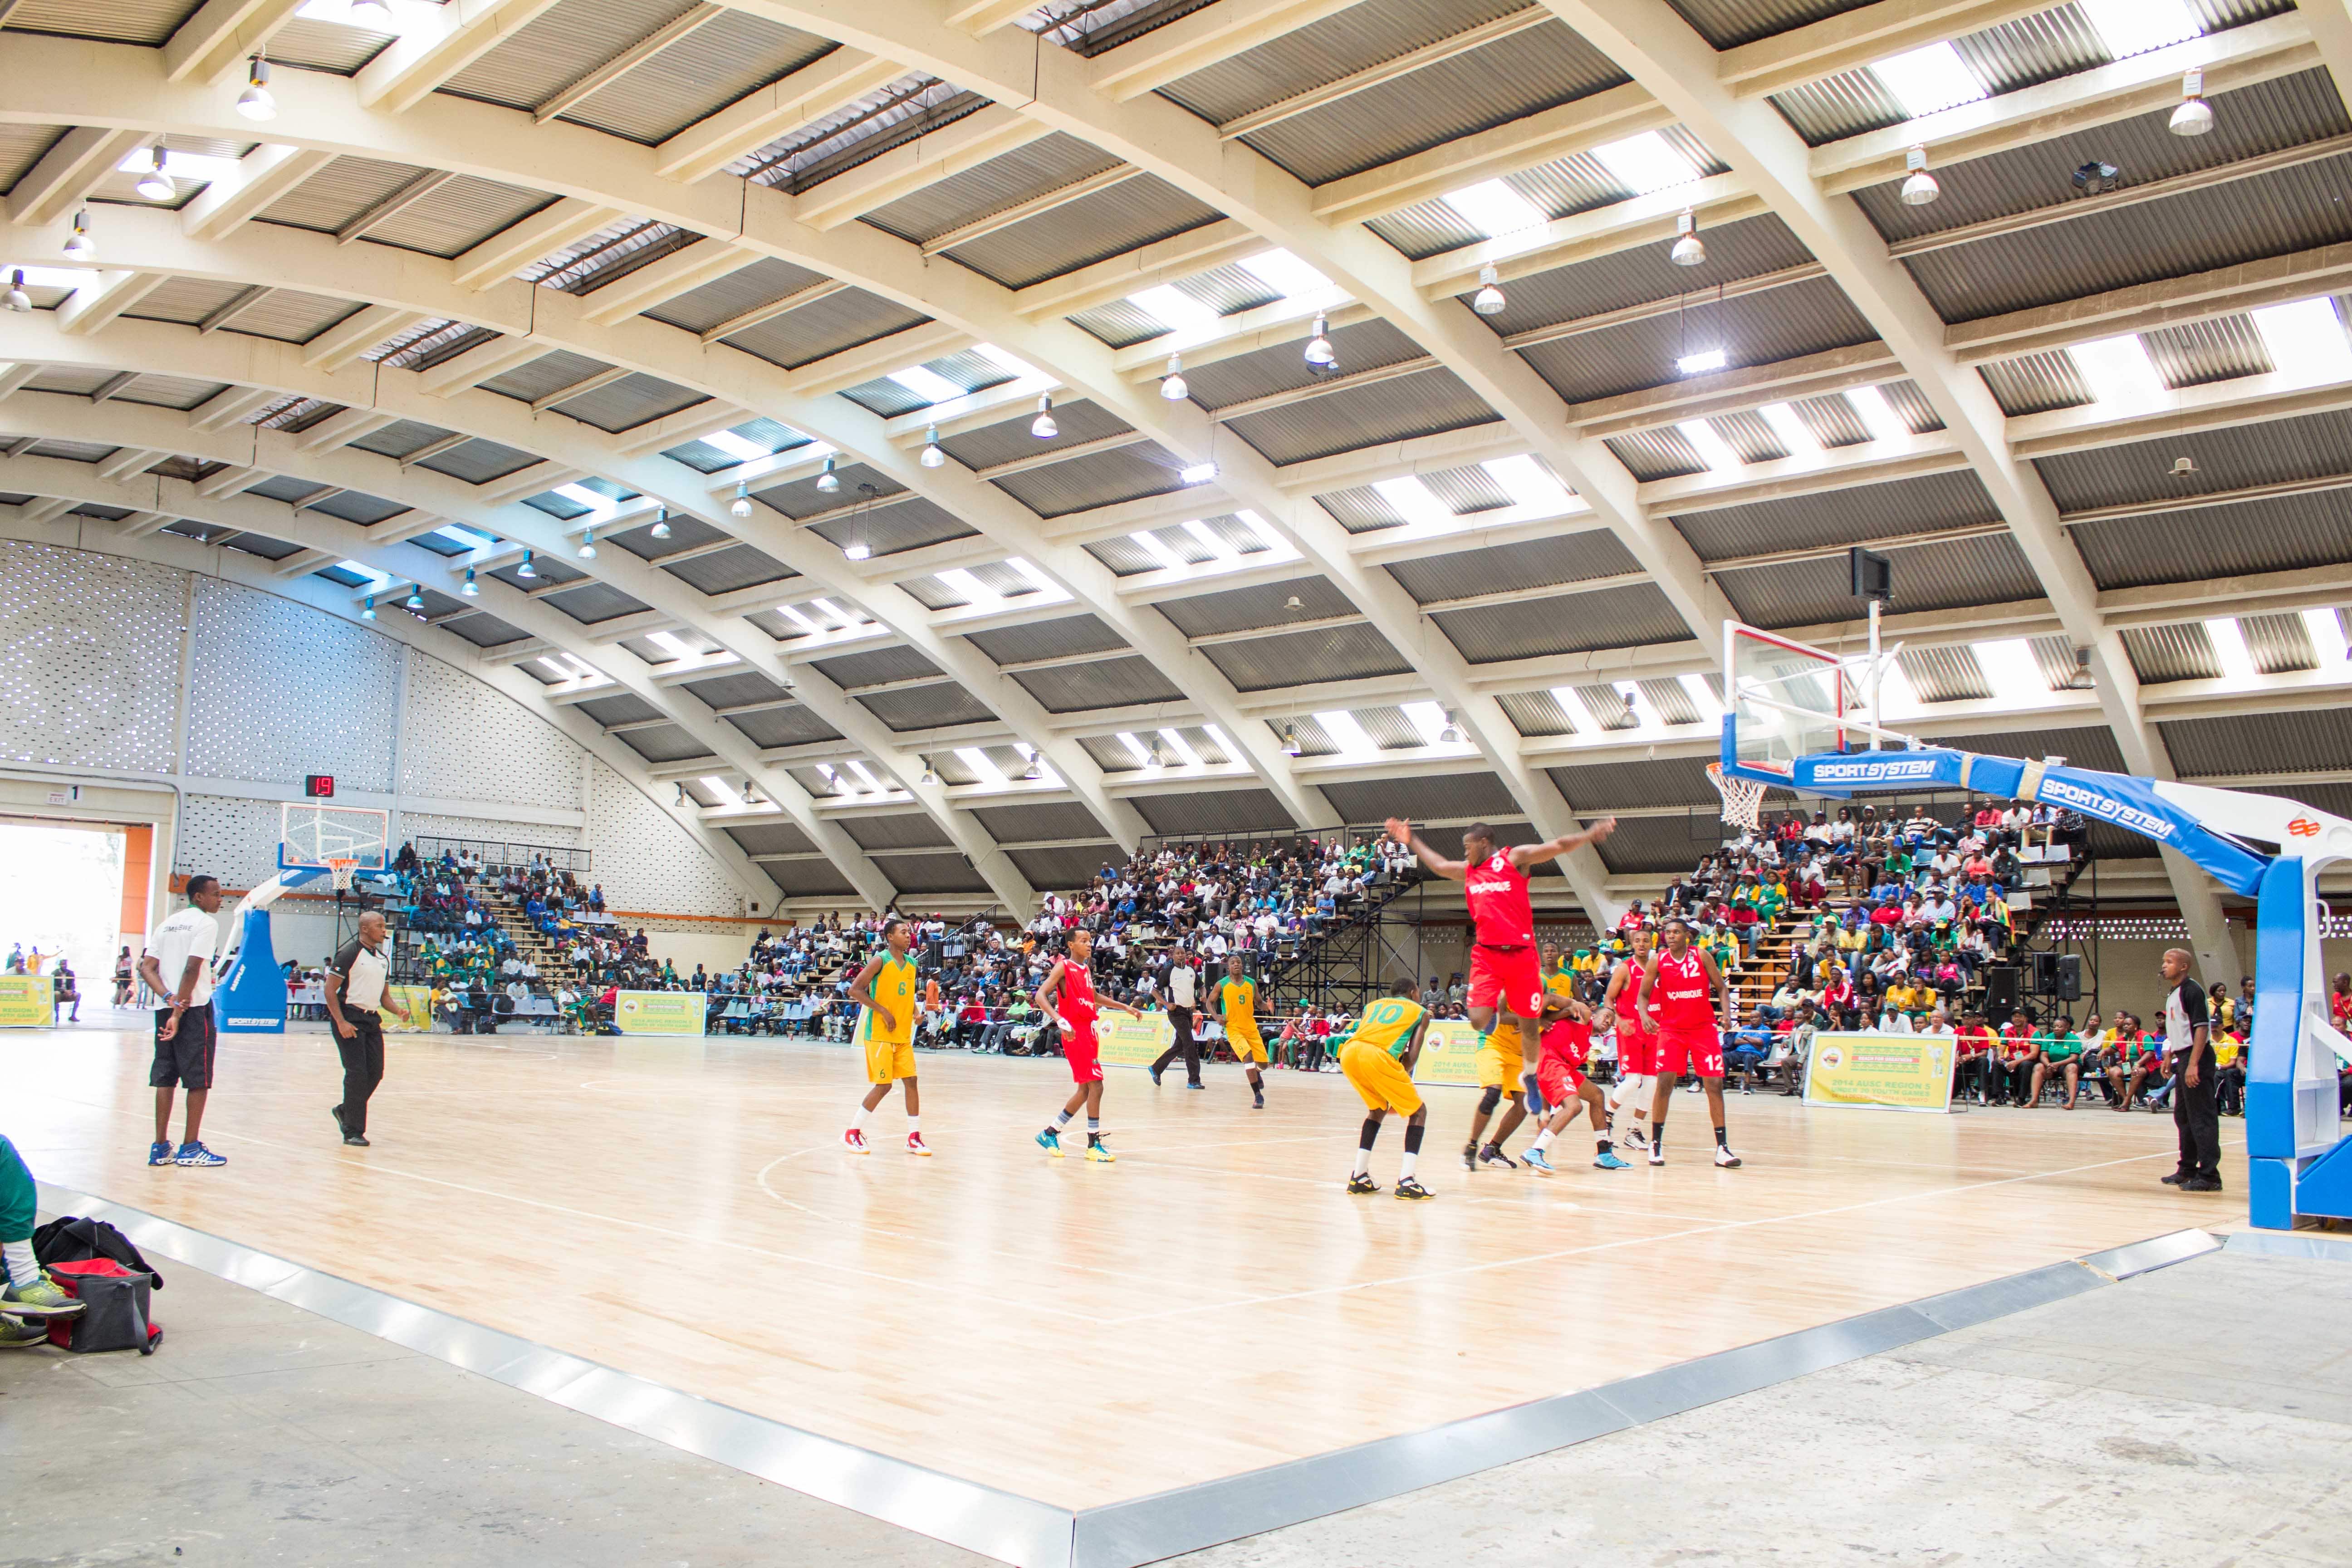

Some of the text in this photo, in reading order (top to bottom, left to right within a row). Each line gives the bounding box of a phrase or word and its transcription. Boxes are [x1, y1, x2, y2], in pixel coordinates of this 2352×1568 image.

[72, 786, 78, 799] 1
[315, 777, 331, 794] 19
[1492, 857, 1504, 872] 9
[1680, 961, 1700, 979] 12
[898, 982, 906, 995] 6
[1238, 995, 1245, 1005] 9
[1530, 992, 1541, 1011] 9
[1367, 1003, 1404, 1024] 10
[1705, 1054, 1724, 1070] 12
[880, 1069, 885, 1078] 6
